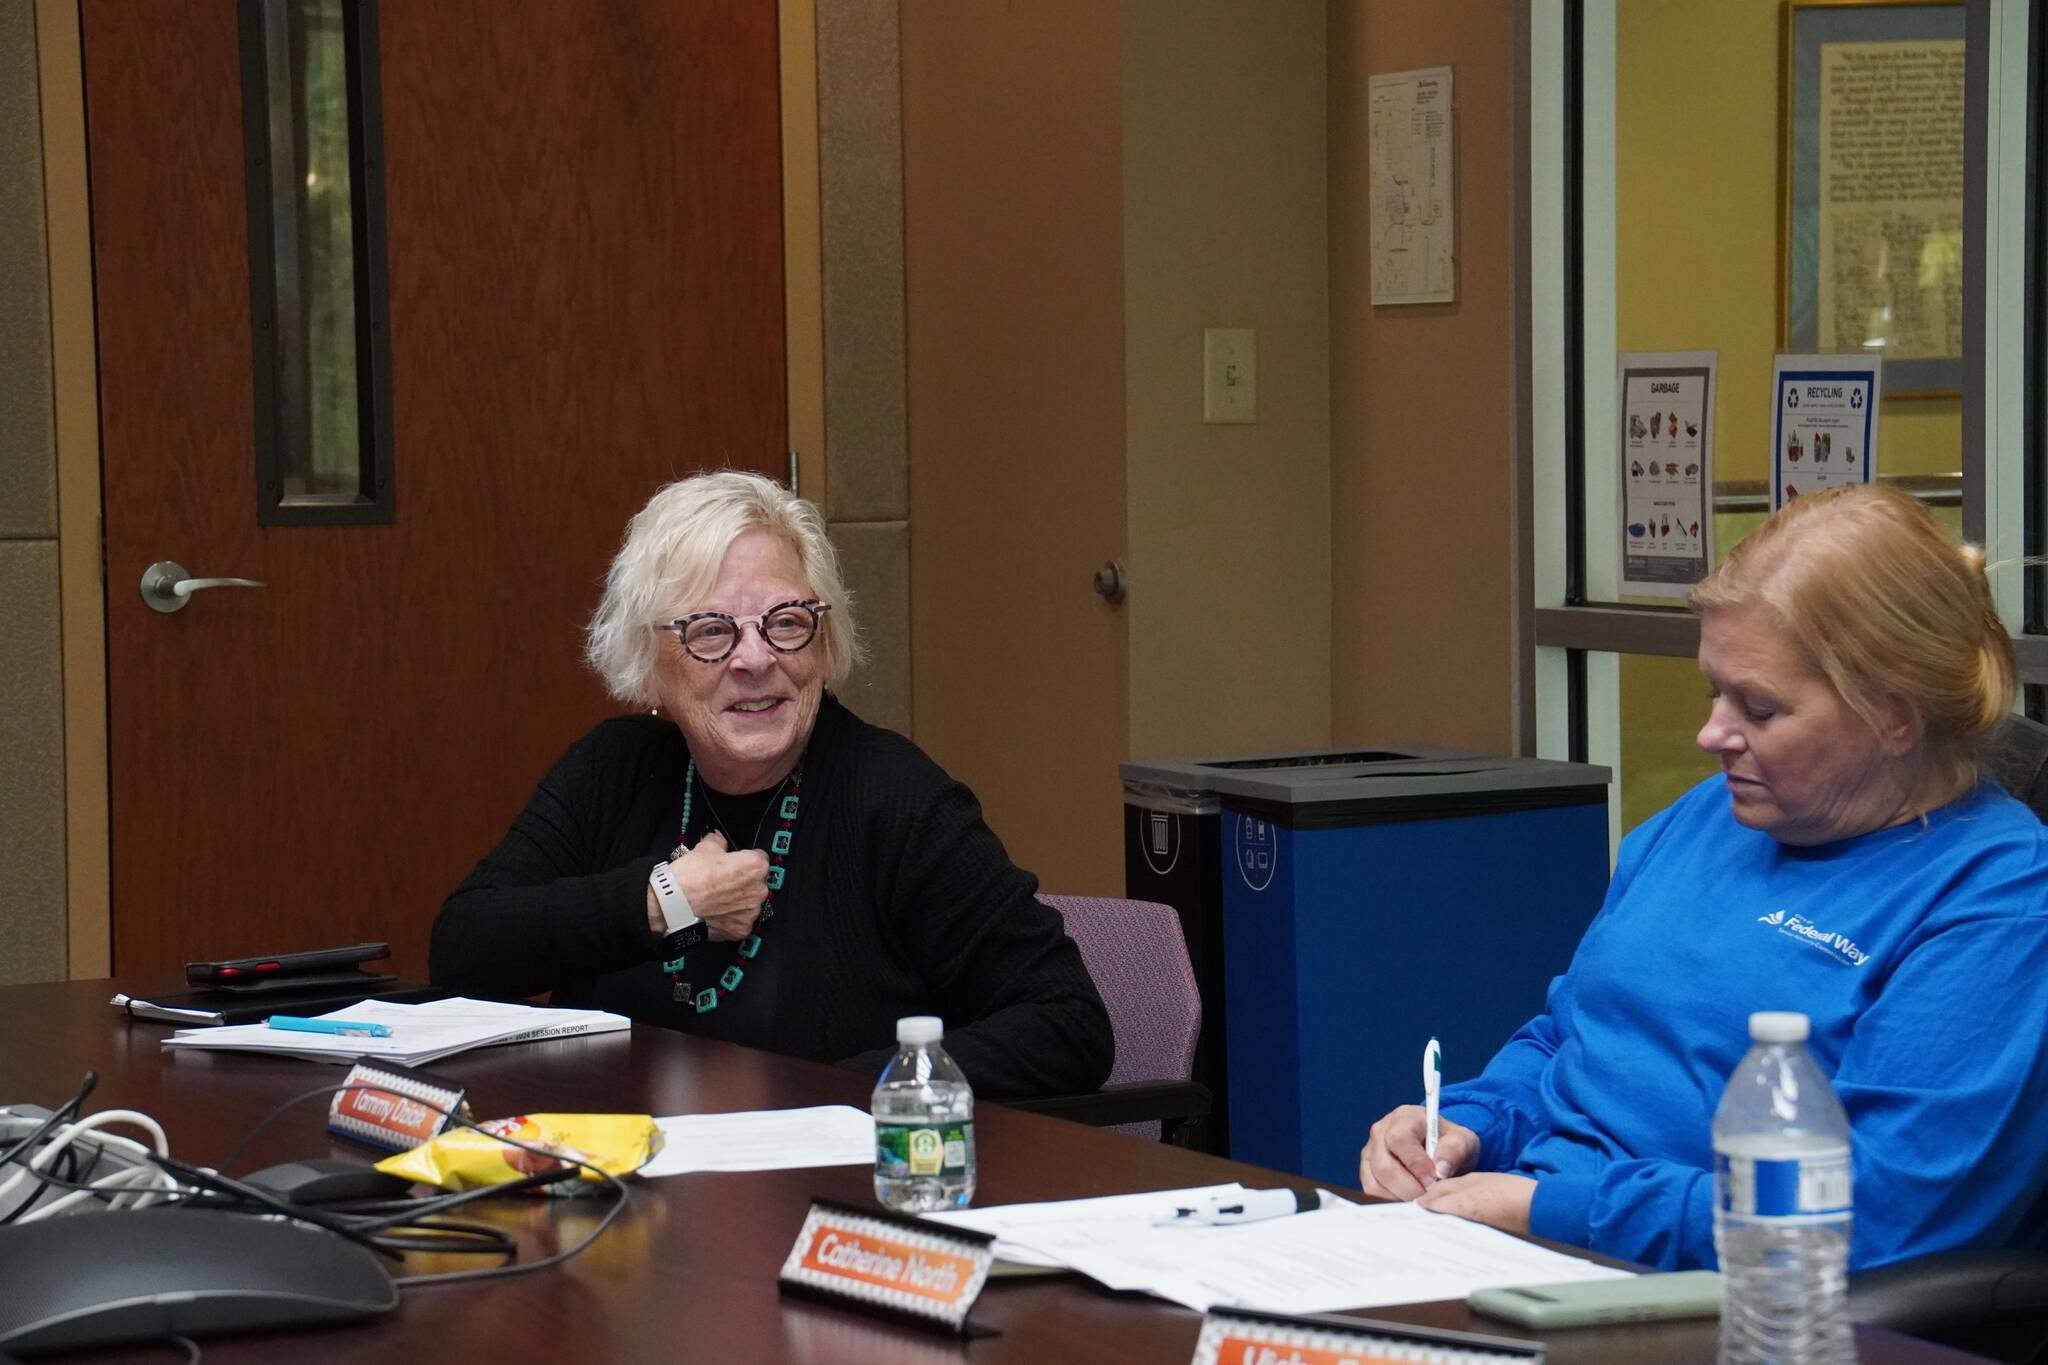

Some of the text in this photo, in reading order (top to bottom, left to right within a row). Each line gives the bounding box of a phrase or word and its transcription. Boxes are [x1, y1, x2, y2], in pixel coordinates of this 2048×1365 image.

[1651, 382, 1680, 394] GARBAGE
[1807, 387, 1843, 399] RECYCLING
[1784, 917, 1836, 943] Fedeal
[1834, 934, 1870, 966] Way
[531, 1028, 561, 1039] SESSION
[561, 1024, 589, 1035] REPORT
[817, 1233, 902, 1280] Catherine
[902, 1253, 957, 1292] North
